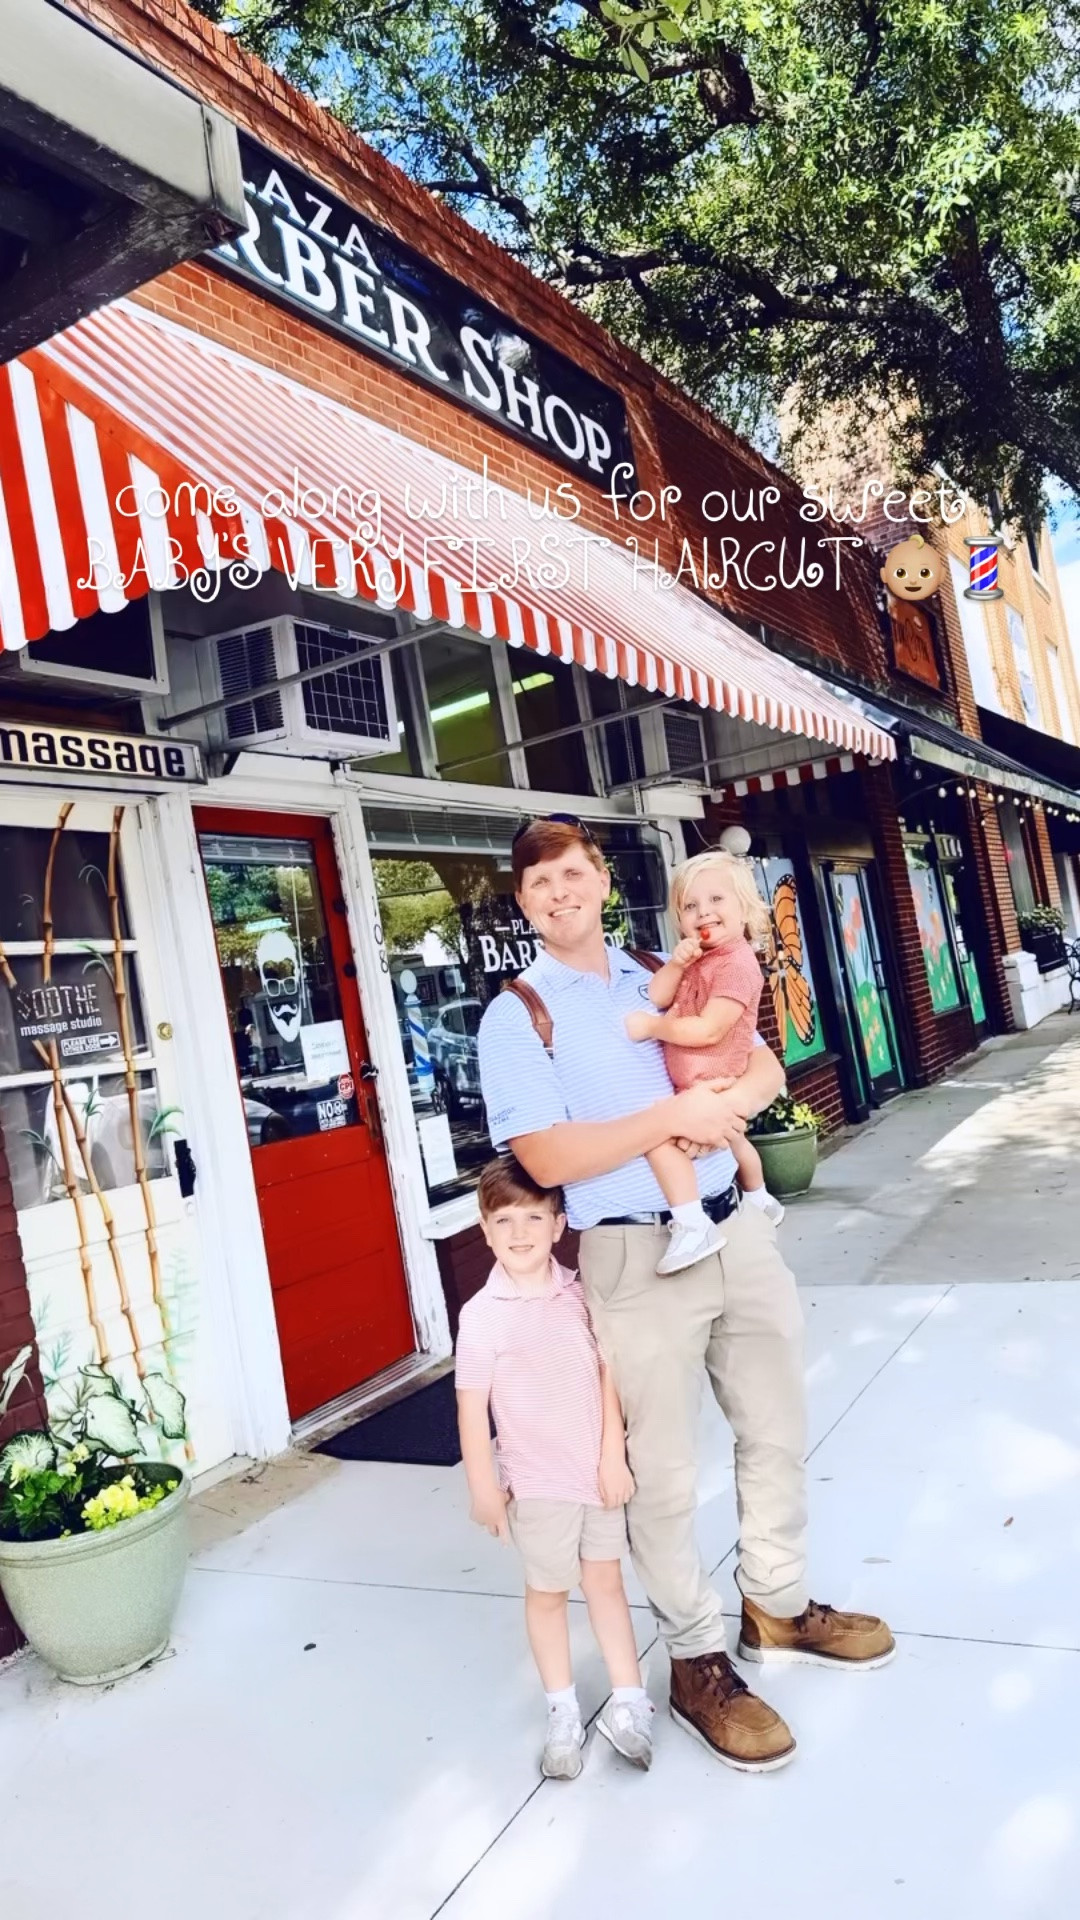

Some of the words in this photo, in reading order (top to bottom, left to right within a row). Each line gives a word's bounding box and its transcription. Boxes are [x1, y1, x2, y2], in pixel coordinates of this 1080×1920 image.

[243, 169, 380, 275] AZA
[217, 199, 449, 382] RBER
[459, 325, 612, 474] SHOP
[0, 728, 186, 777] massage
[371, 895, 389, 974] 108
[511, 919, 539, 936] PLA
[604, 932, 625, 949] OP
[17, 984, 100, 1020] SOOTHE
[20, 1022, 68, 1037] massage
[70, 1016, 102, 1030] studio
